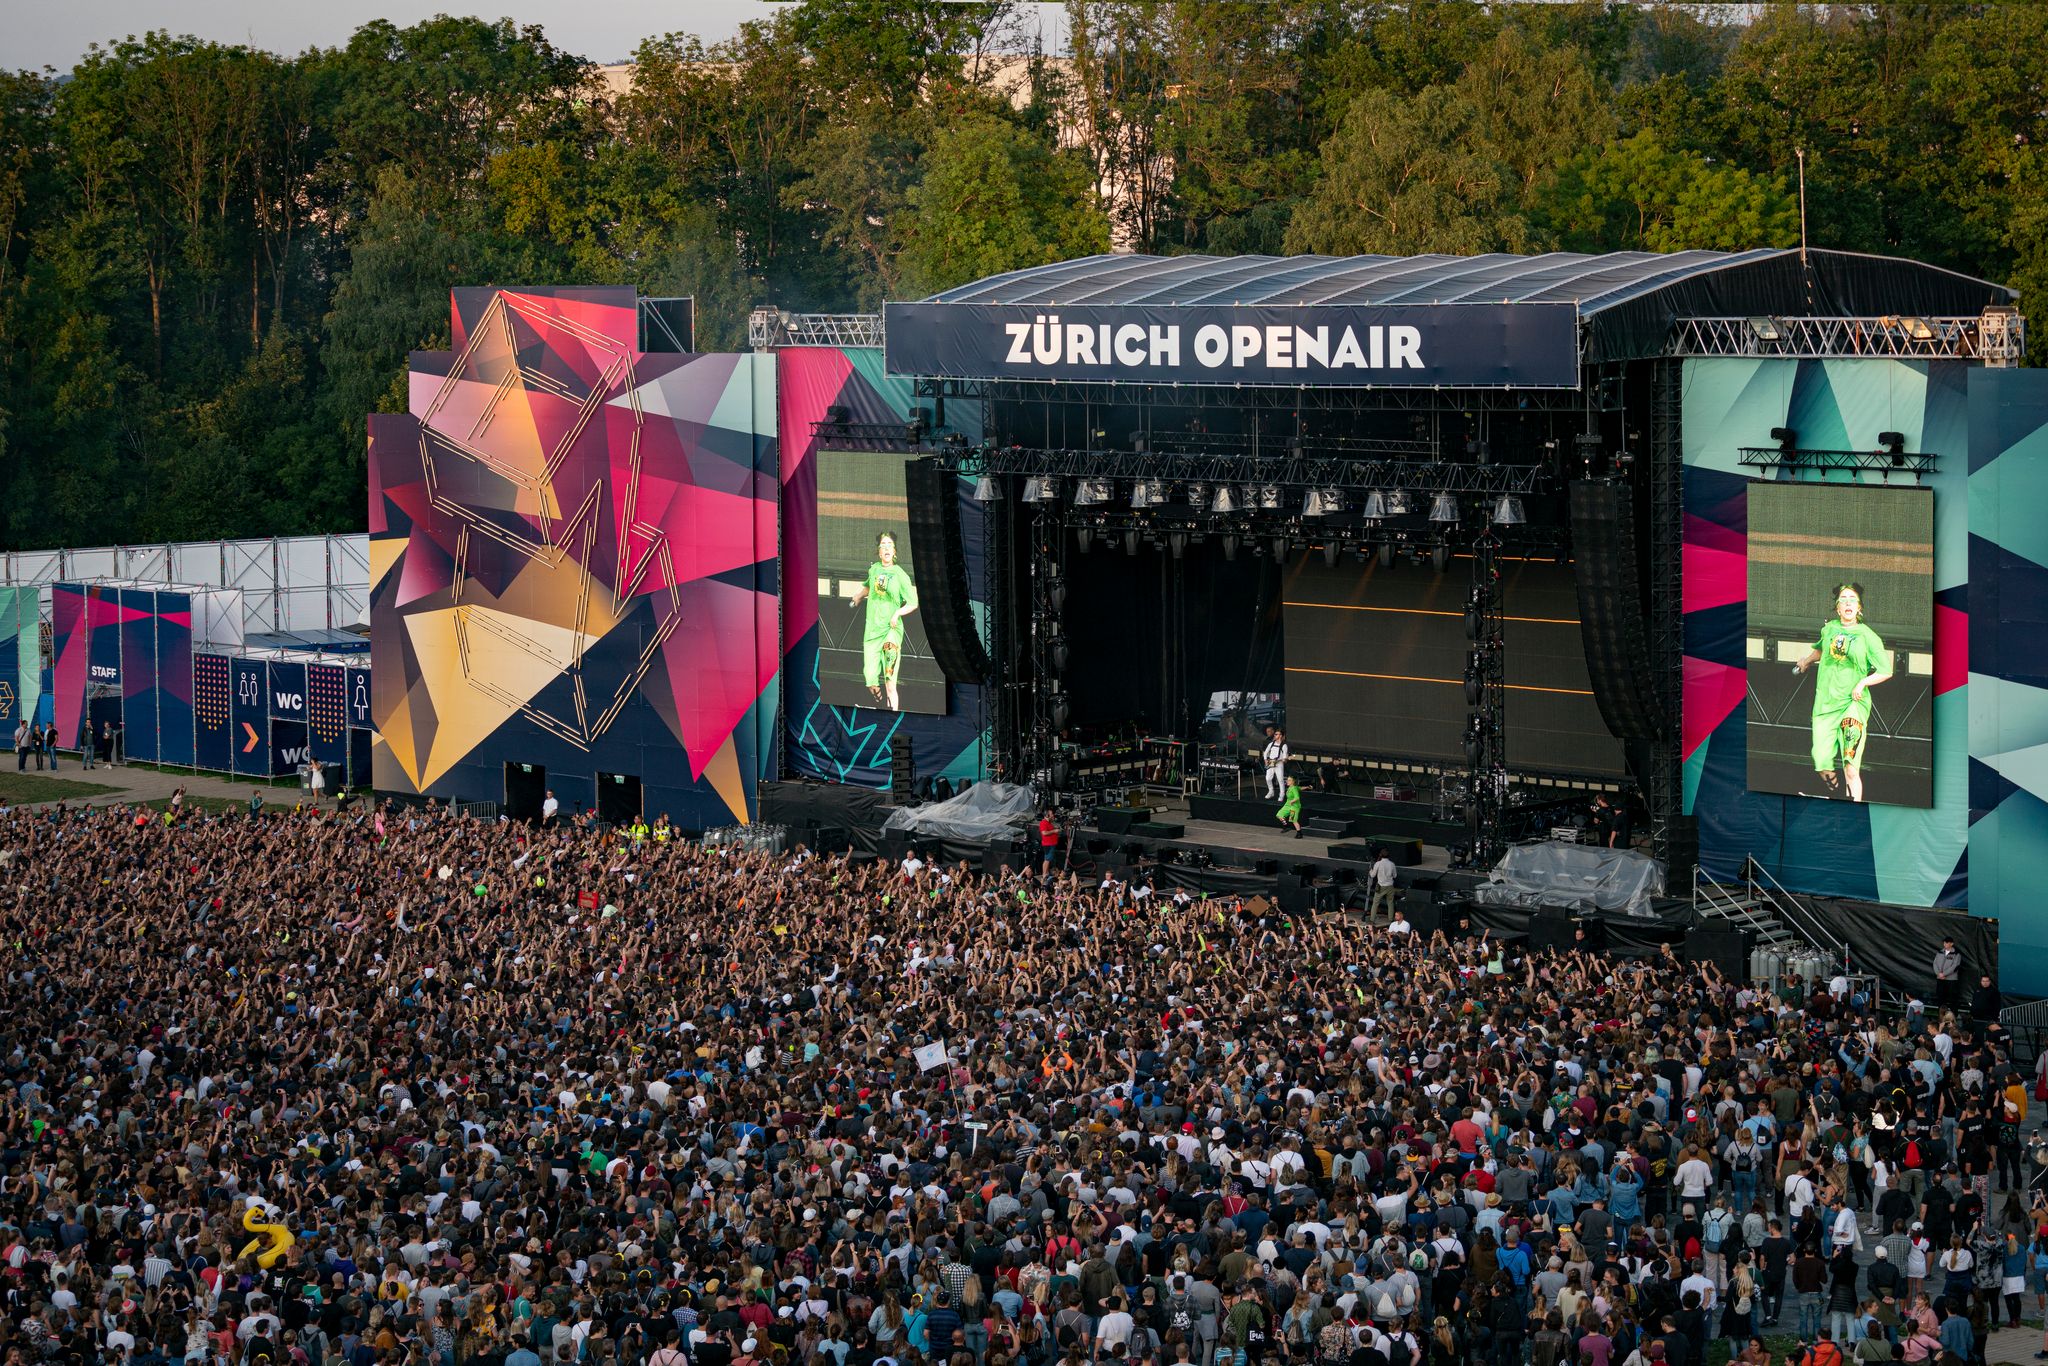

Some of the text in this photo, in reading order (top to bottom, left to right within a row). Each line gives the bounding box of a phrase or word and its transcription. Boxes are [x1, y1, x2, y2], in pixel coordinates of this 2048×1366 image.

[1005, 315, 1426, 369] ZÜRICH OPENAIR
[91, 665, 117, 678] STAFF
[276, 691, 303, 711] WC
